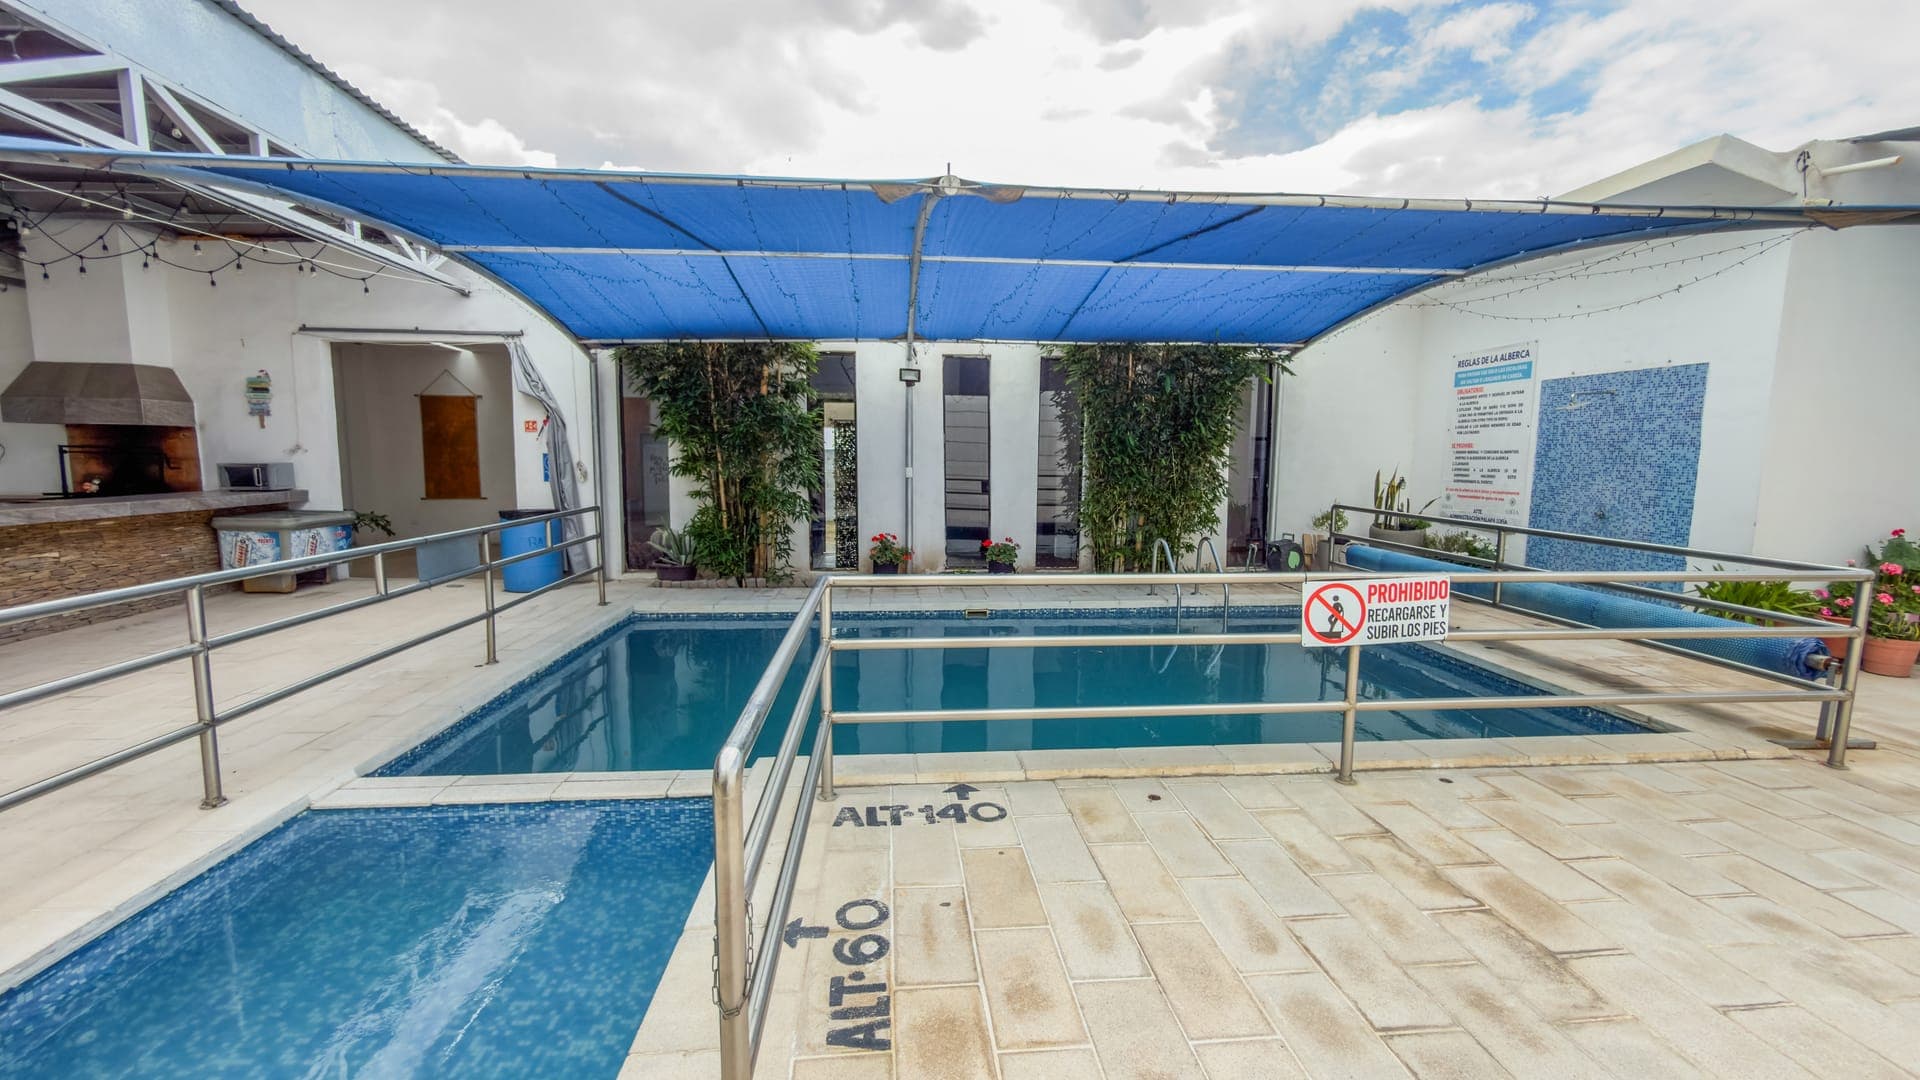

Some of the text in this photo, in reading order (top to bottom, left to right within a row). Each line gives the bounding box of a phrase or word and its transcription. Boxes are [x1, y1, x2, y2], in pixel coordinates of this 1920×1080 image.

[1457, 349, 1530, 368] REGLAS DE LA ALBERCA
[1367, 580, 1448, 604] PROHIBIDO
[1368, 604, 1447, 623] RECARGARSE Y
[1367, 621, 1446, 640] SUBIR LOS PIES
